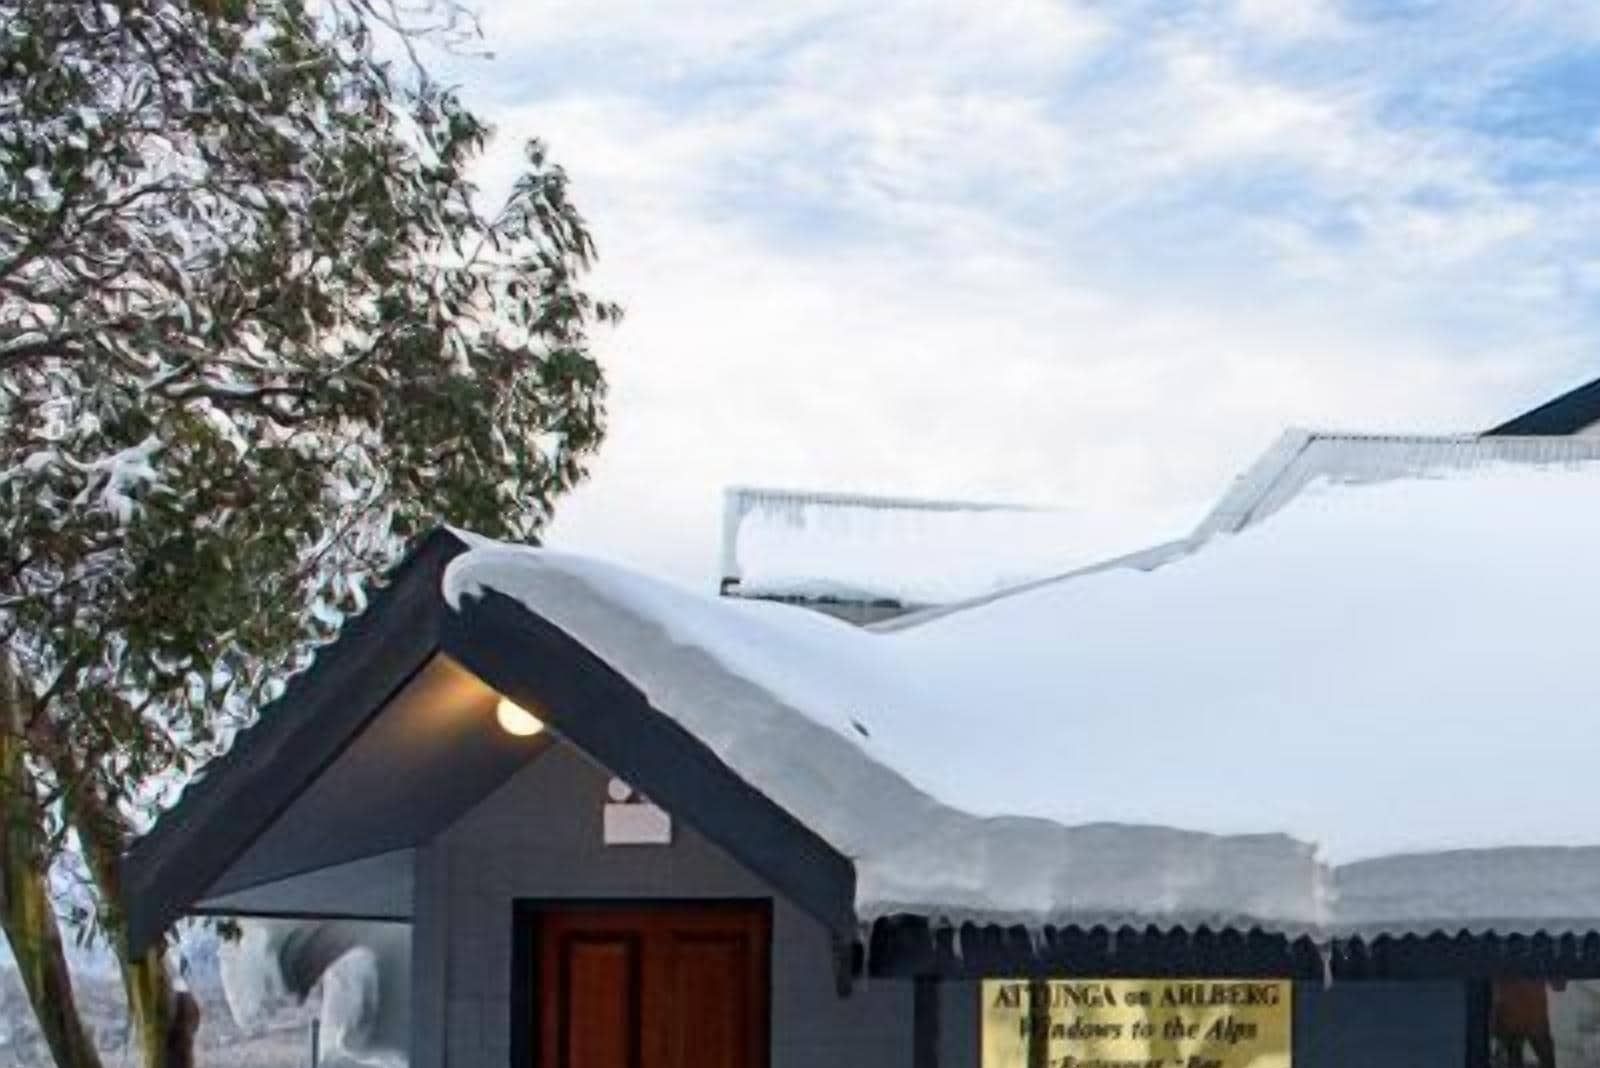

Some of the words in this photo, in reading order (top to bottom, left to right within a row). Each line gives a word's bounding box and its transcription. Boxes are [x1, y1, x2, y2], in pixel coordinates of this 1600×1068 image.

[1160, 983, 1280, 1007] ARLBERG
[1132, 1020, 1154, 1040] to
[1163, 1016, 1199, 1040] the
[1204, 1015, 1257, 1044] Alps
